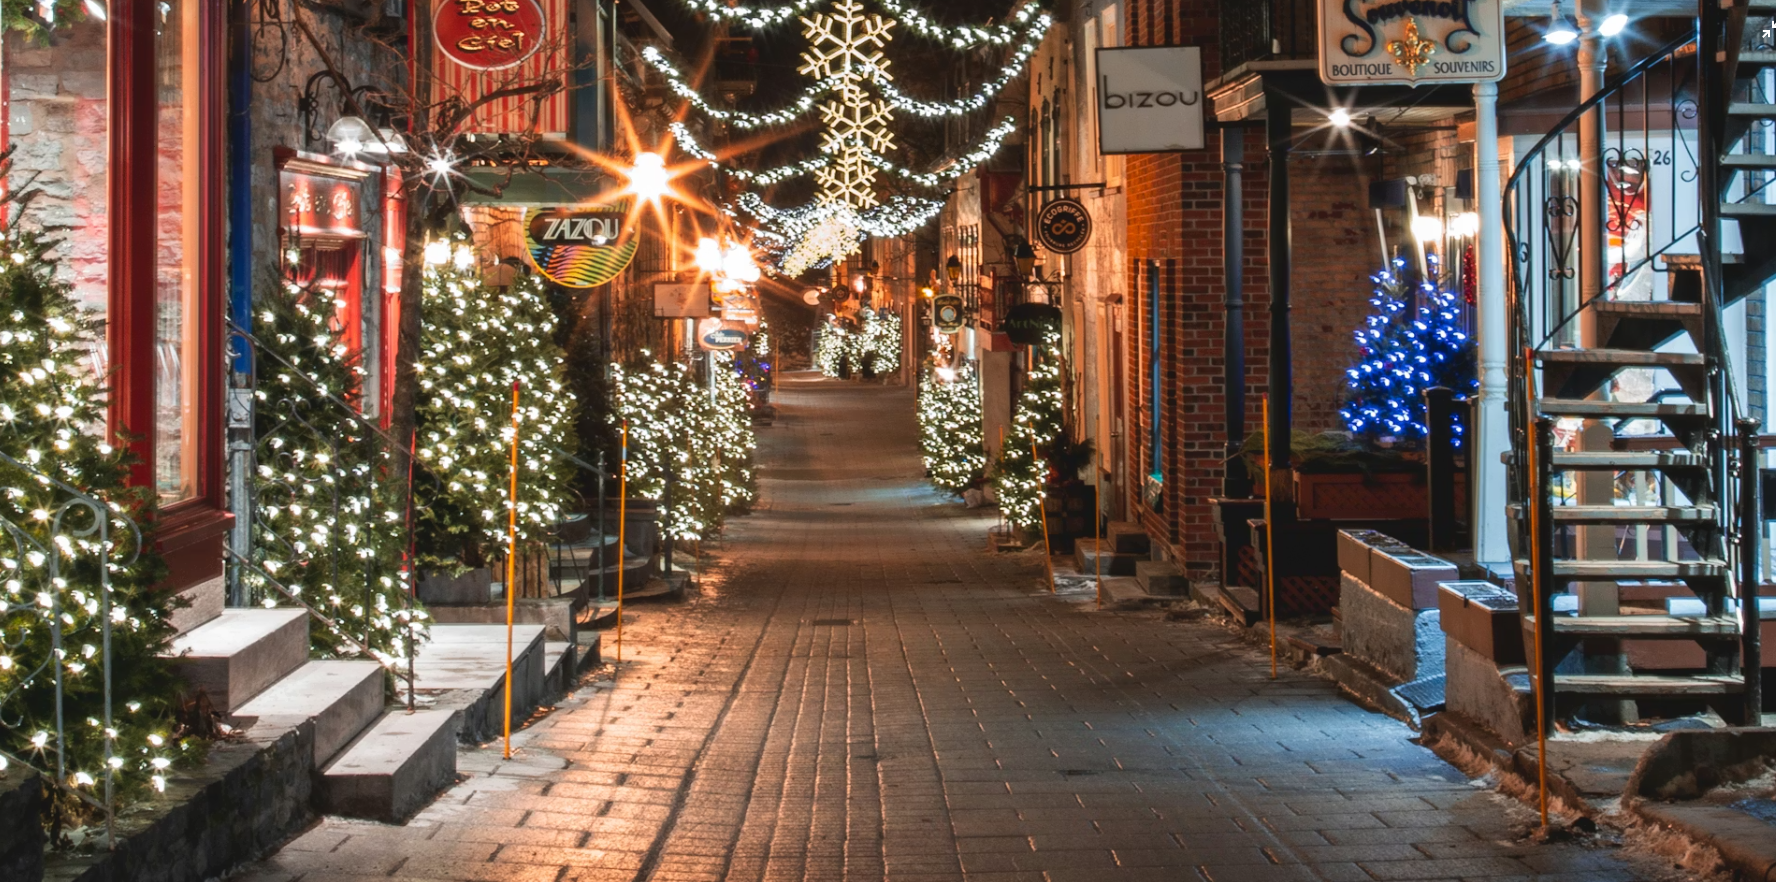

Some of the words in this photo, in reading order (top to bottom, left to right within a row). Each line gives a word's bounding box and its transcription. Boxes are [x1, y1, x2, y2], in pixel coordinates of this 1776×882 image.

[471, 18, 515, 29] en
[458, 32, 525, 51] Ciel
[1332, 63, 1393, 76] BOUTIQUE
[1434, 61, 1495, 74] SOUVENIRS
[1103, 75, 1198, 109] bizou
[1653, 150, 1671, 165] 26
[1044, 205, 1084, 224] ECOGRIFFE
[543, 218, 619, 240] ZAZOU
